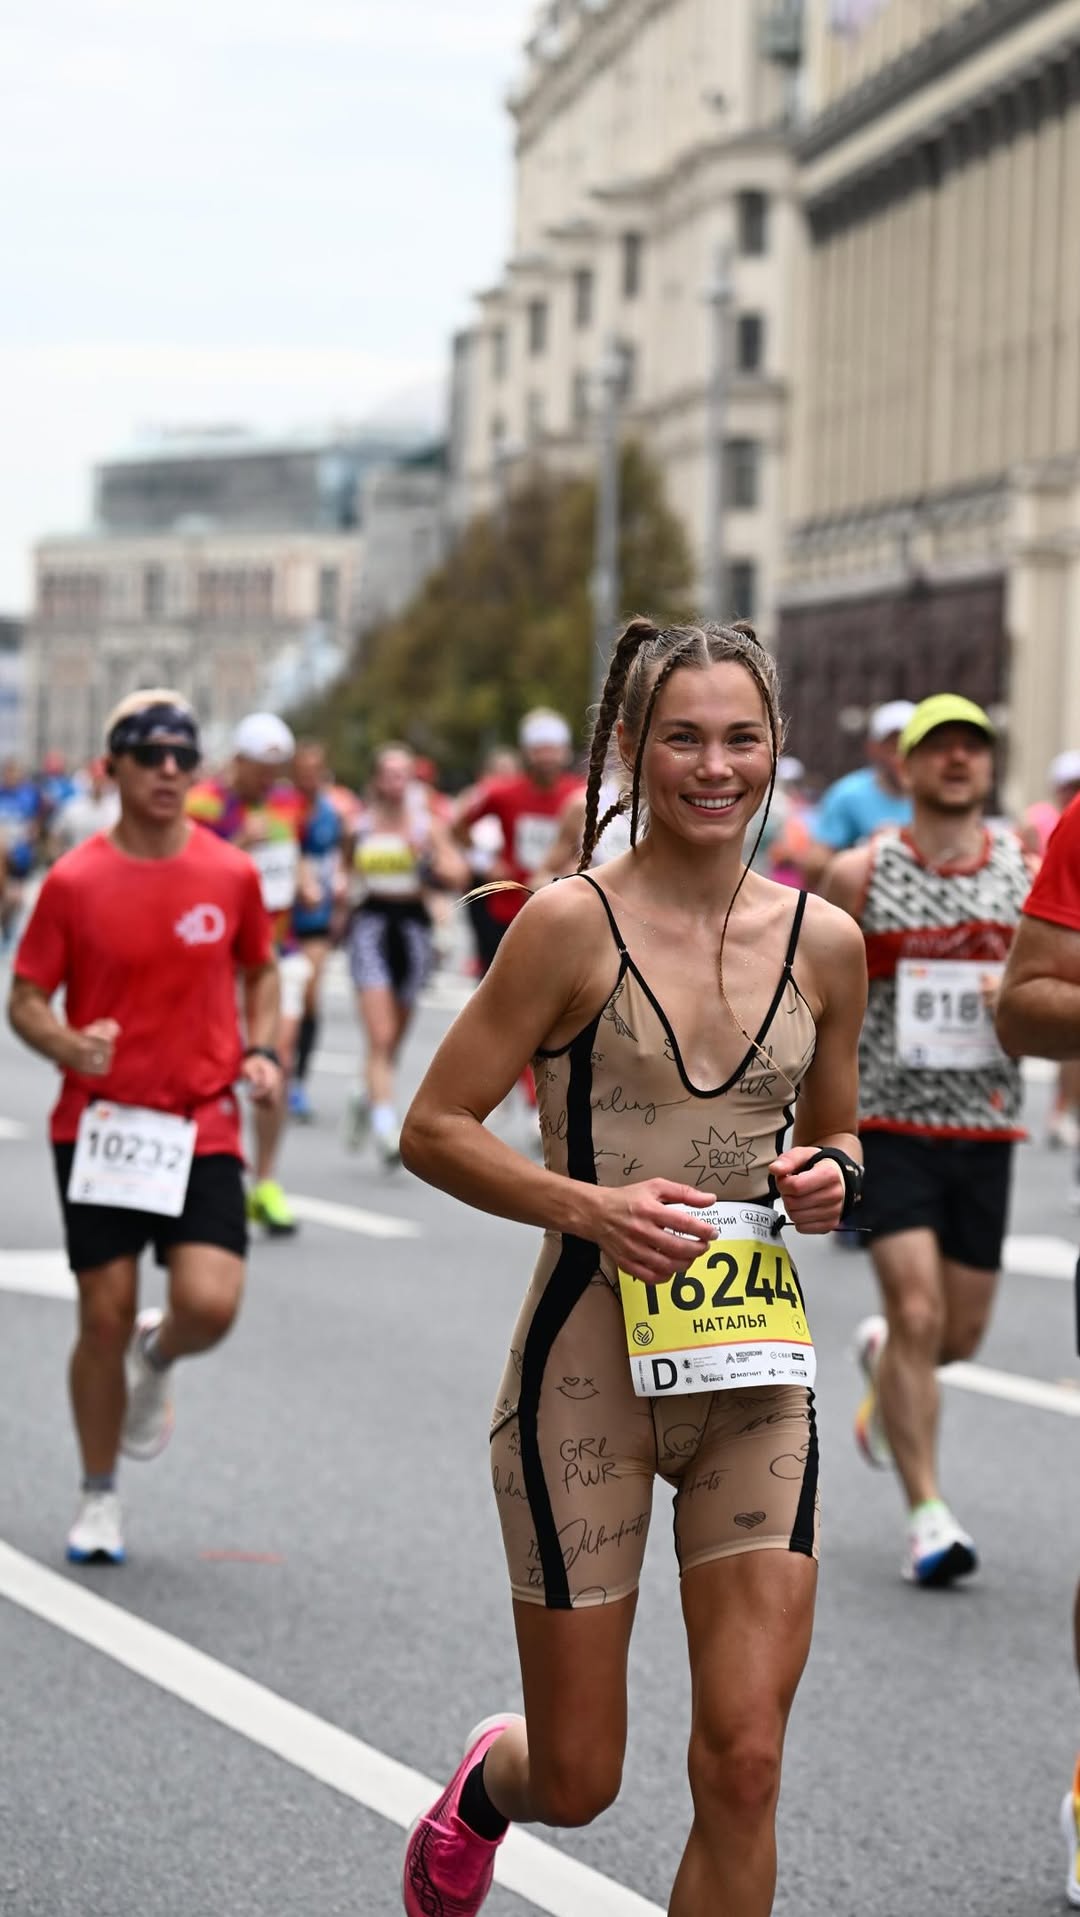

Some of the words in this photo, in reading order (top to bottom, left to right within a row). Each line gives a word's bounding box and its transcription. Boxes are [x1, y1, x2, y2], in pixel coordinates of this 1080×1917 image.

[709, 1149, 745, 1168] BOOM
[632, 1252, 798, 1315] 16244
[693, 1314, 767, 1334] НАТАЛЬЯ
[651, 1358, 678, 1390] D
[562, 1462, 621, 1494] PWR
